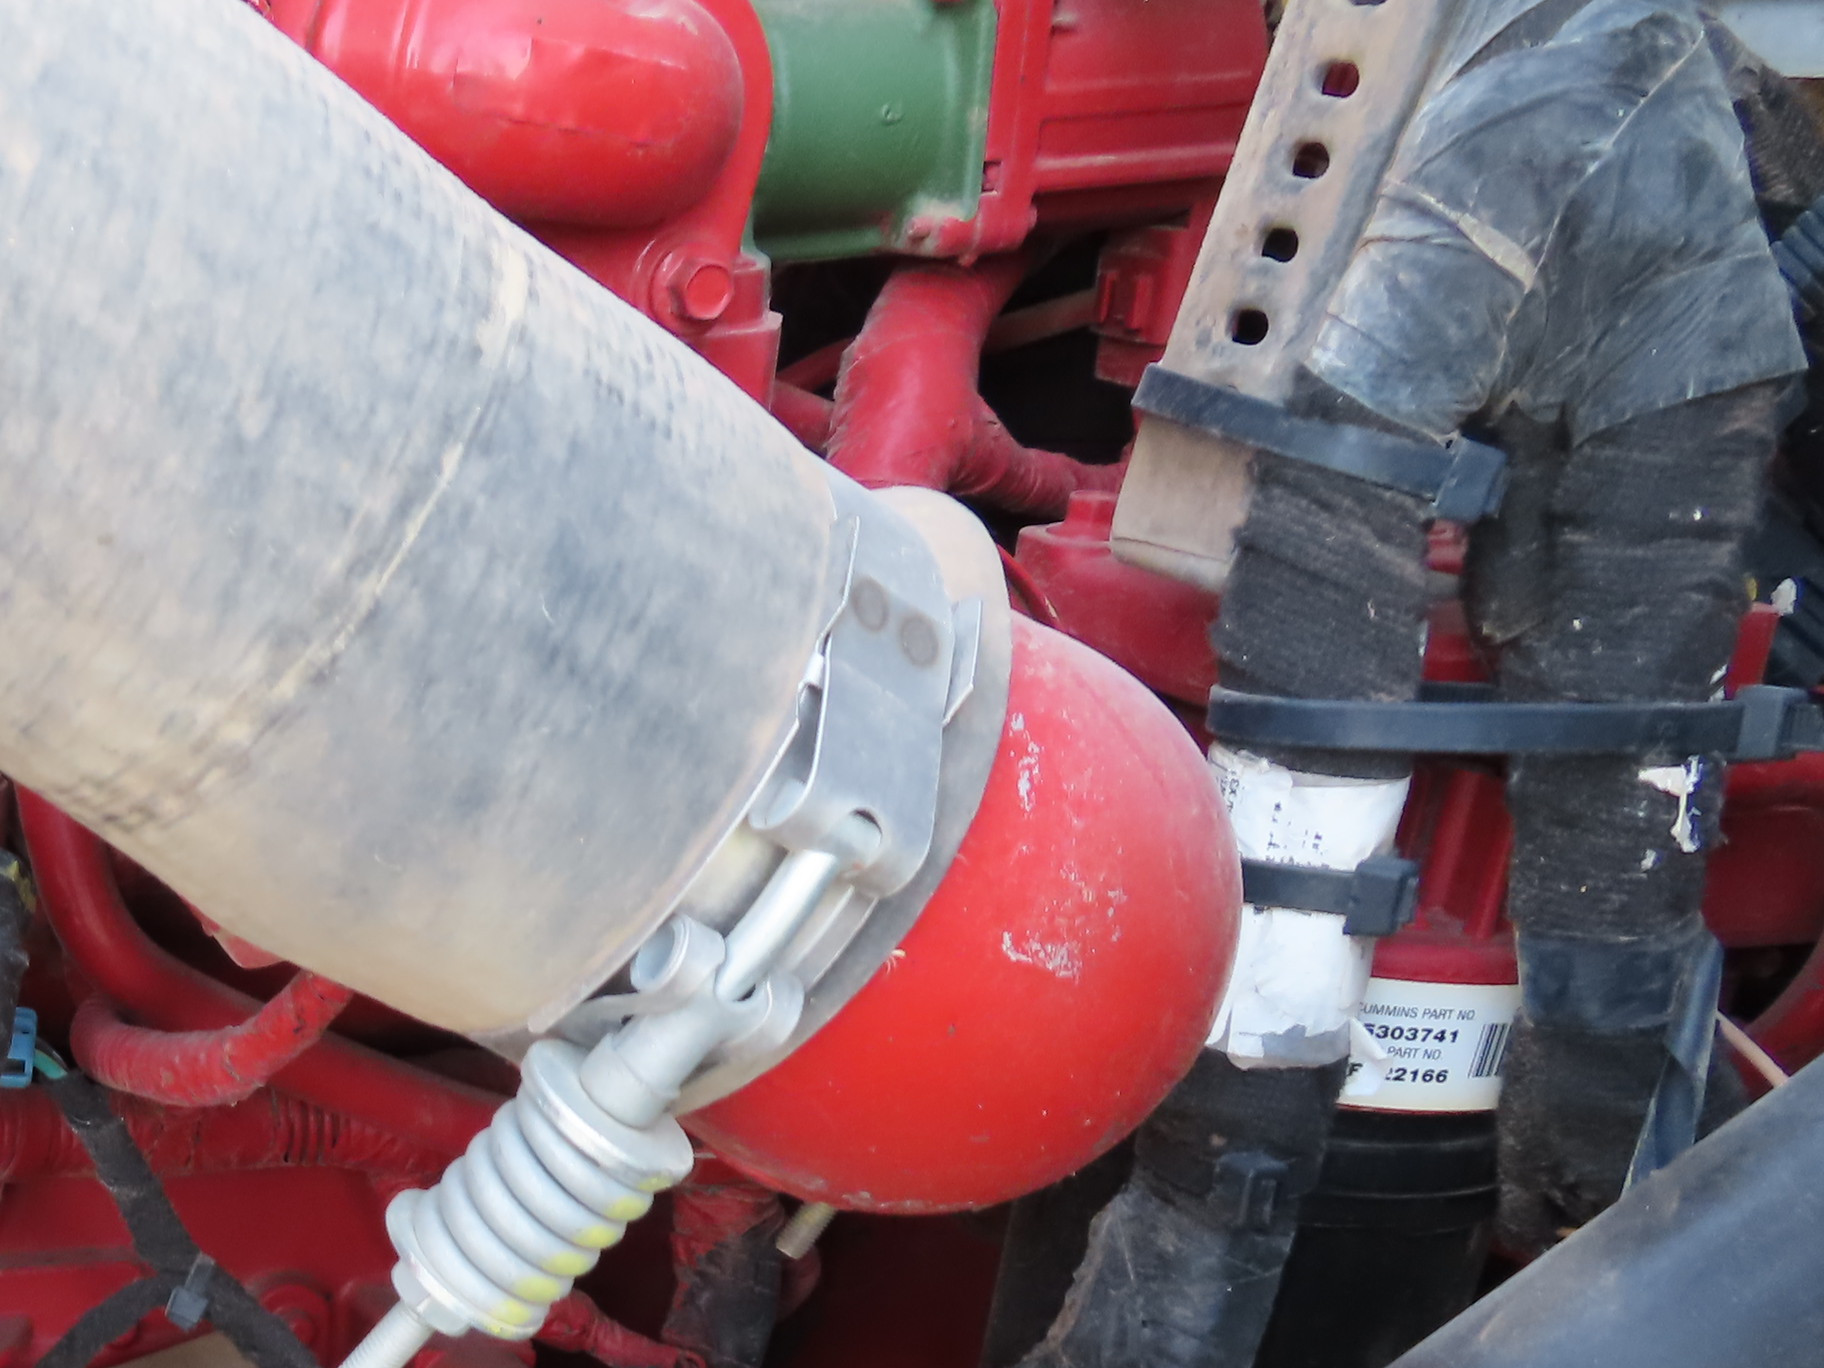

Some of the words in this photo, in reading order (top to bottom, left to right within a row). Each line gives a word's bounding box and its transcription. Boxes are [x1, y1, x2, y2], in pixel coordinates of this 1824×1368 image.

[1359, 1002, 1418, 1020] UMMINS
[1421, 1008, 1454, 1021] PART
[1457, 1010, 1476, 1022] NO
[1387, 1045, 1419, 1060] PART
[1423, 1048, 1442, 1061] NO
